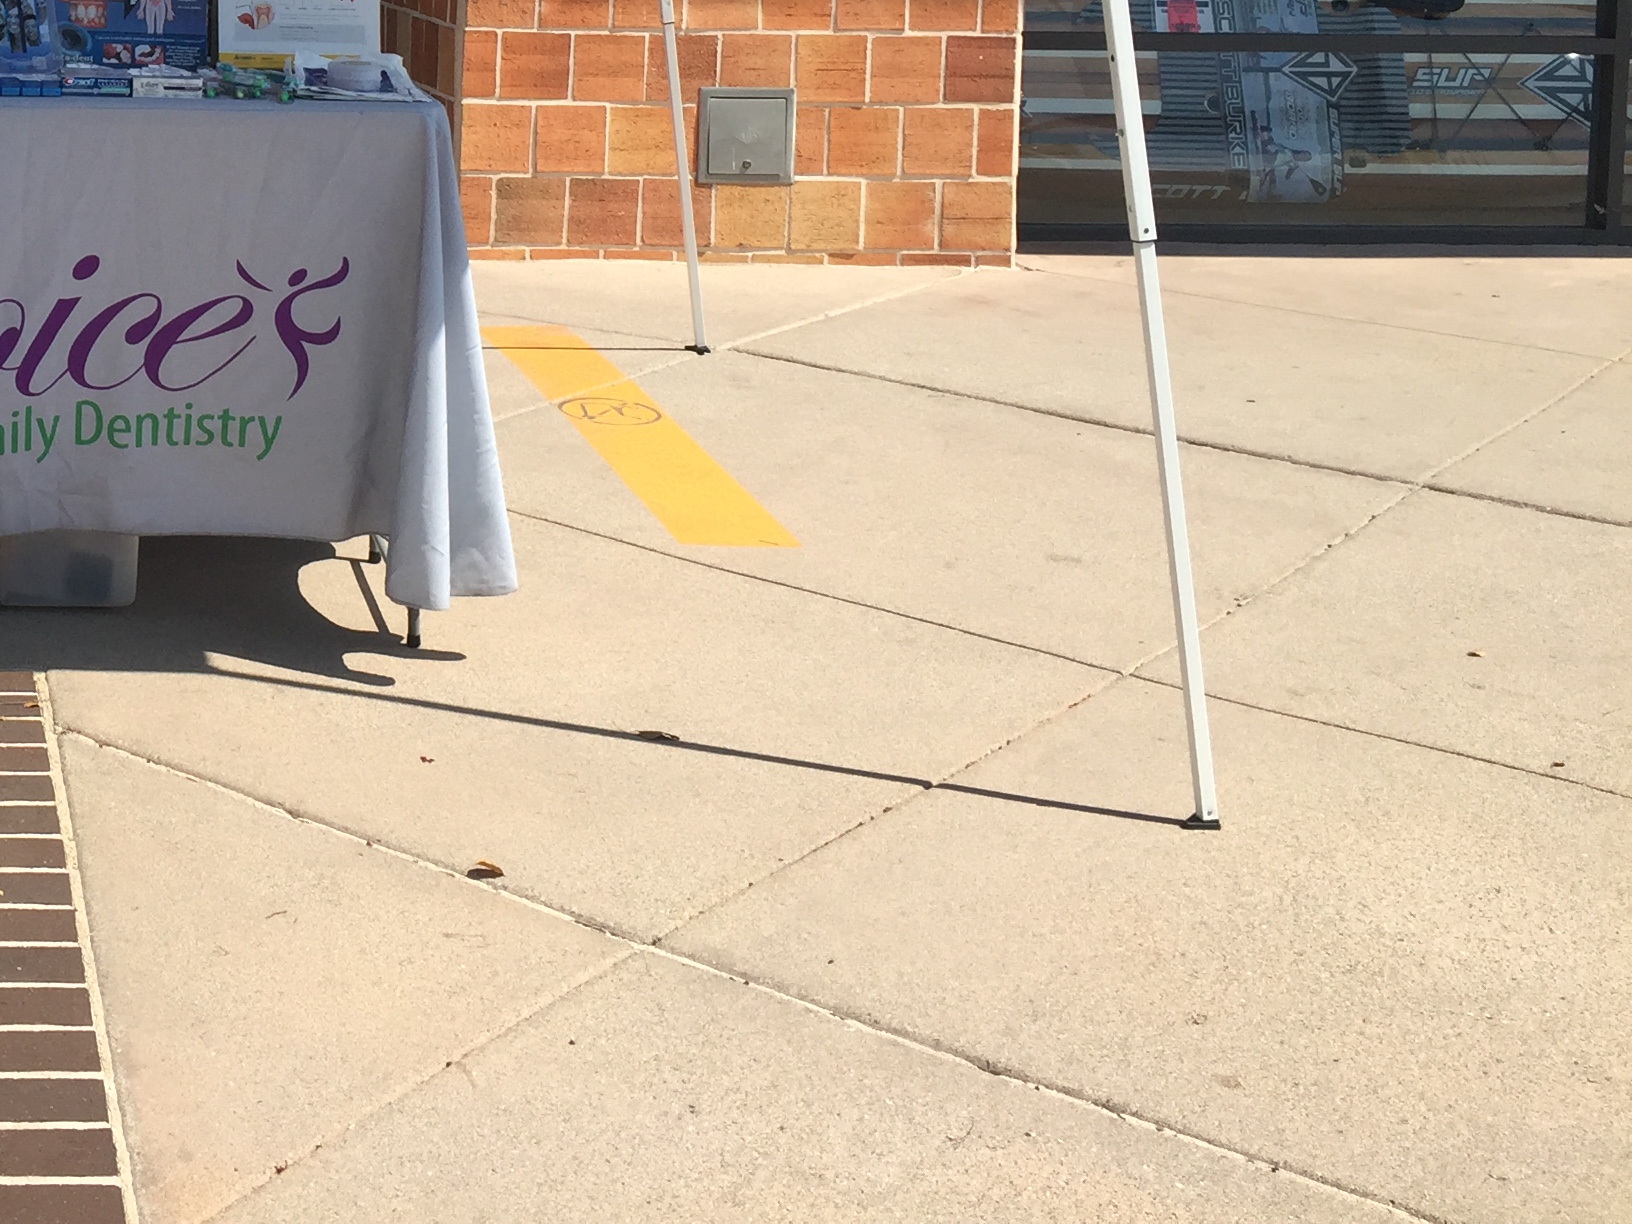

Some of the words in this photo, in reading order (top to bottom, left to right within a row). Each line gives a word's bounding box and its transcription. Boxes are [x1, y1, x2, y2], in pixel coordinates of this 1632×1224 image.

[1215, 0, 1240, 81] SCTT
[1411, 67, 1493, 87] SUP
[1224, 83, 1248, 169] BURKE
[1152, 184, 1232, 200] COTT
[73, 398, 283, 461] Dentistry
